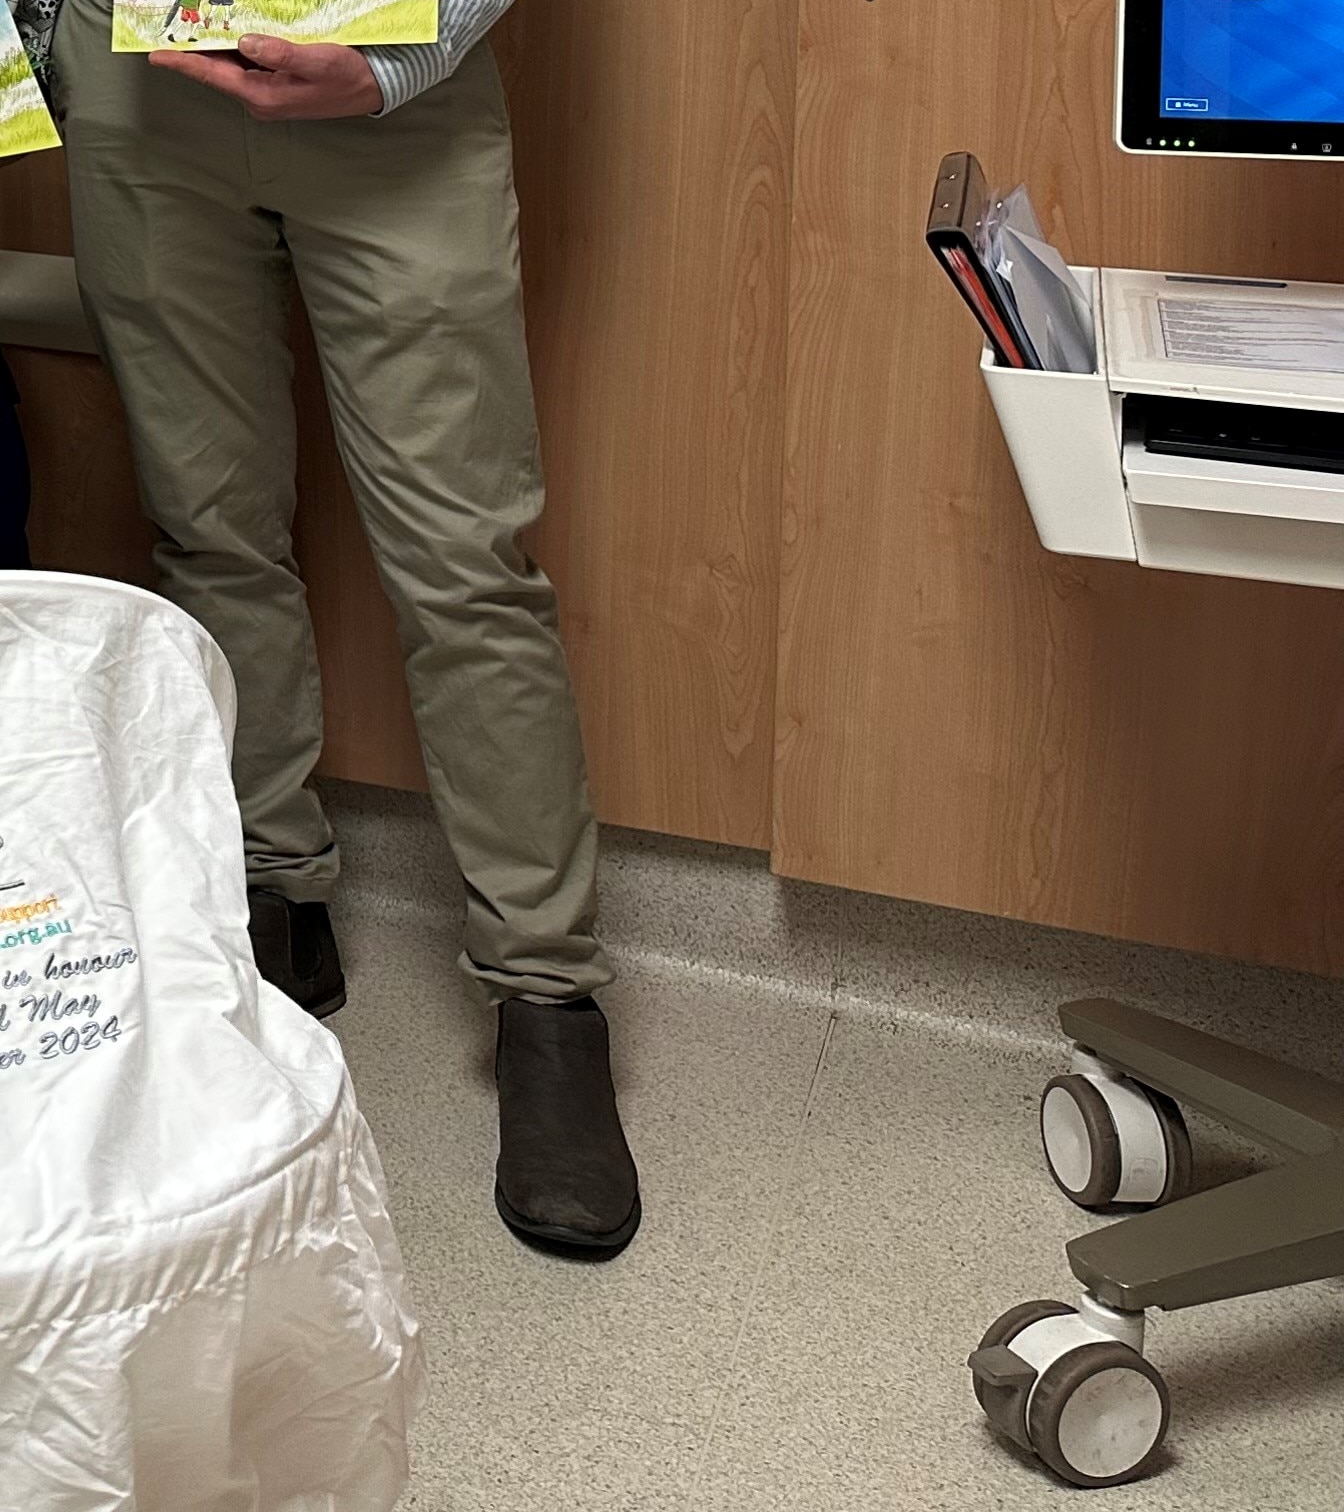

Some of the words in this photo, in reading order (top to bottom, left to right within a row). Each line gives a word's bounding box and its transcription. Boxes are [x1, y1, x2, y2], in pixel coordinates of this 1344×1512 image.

[2, 970, 32, 989] in
[43, 947, 138, 980] honour
[18, 990, 102, 1023] May
[39, 1015, 122, 1060] 2024
